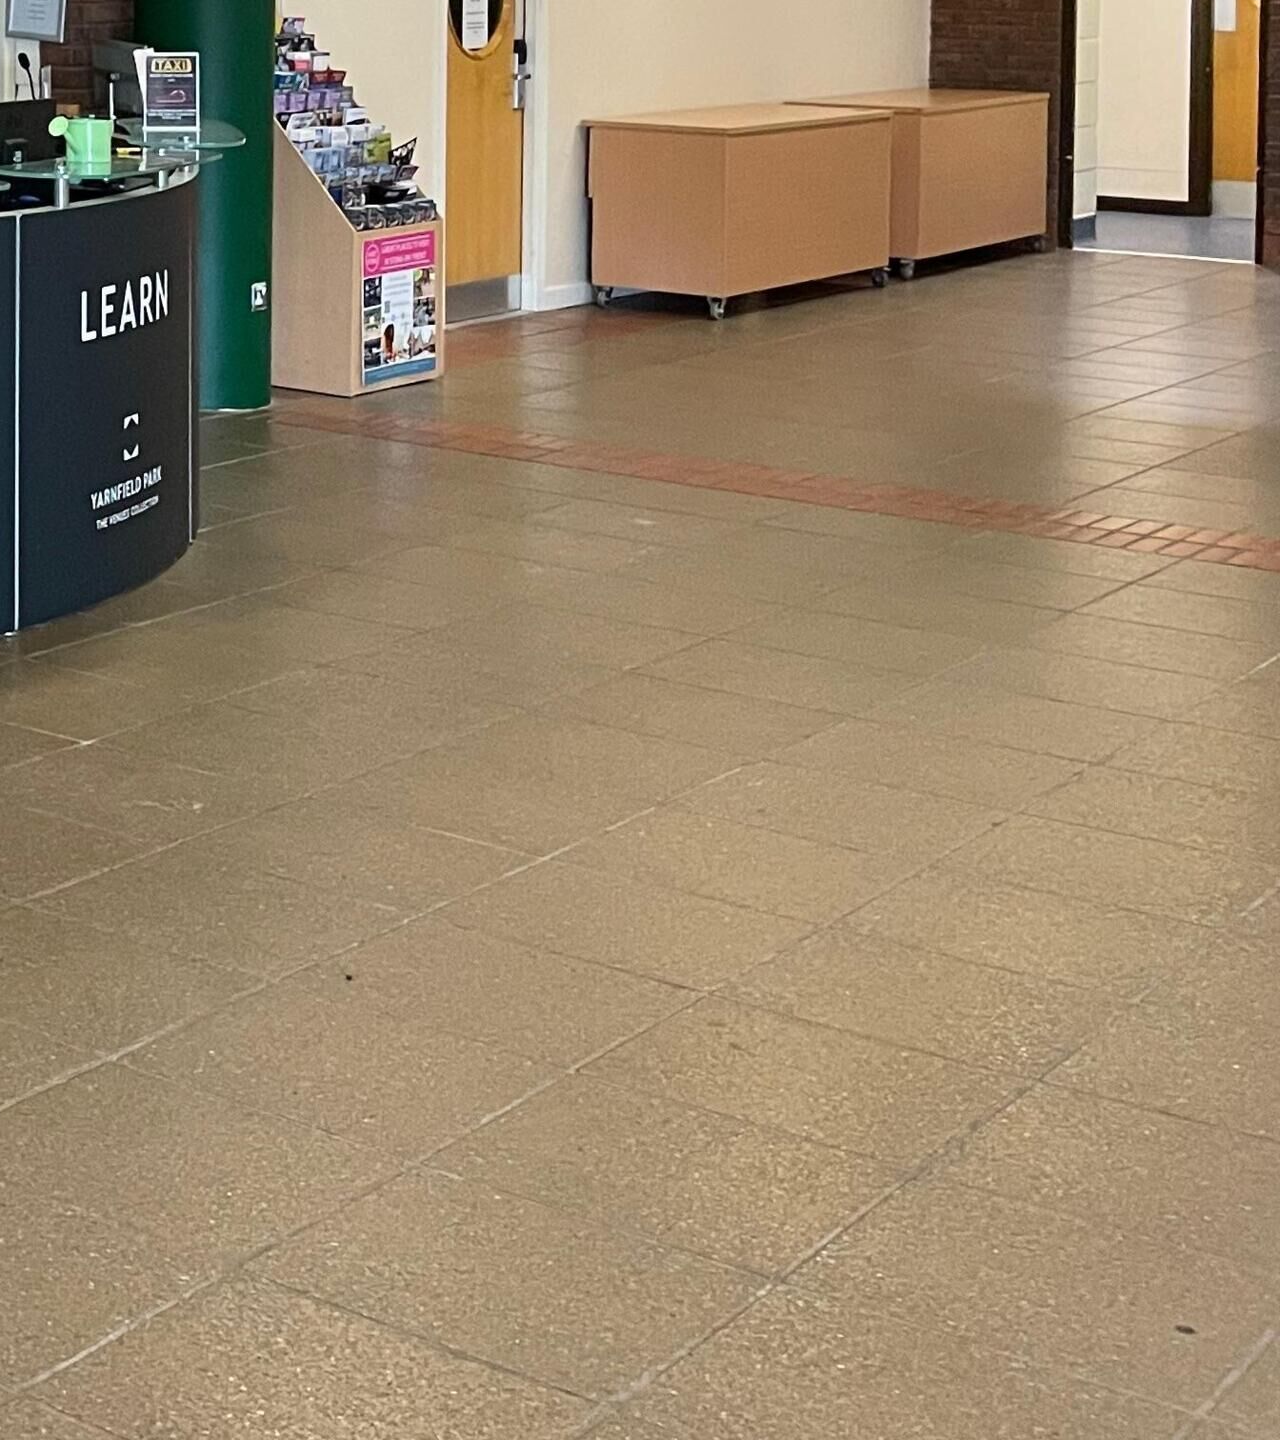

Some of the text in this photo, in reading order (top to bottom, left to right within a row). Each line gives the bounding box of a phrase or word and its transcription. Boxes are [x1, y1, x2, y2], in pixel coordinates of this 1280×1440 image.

[154, 60, 188, 71] TAXI
[81, 269, 169, 343] LEARN
[90, 465, 162, 510] YARNFIELD PARK
[96, 516, 108, 530] THE
